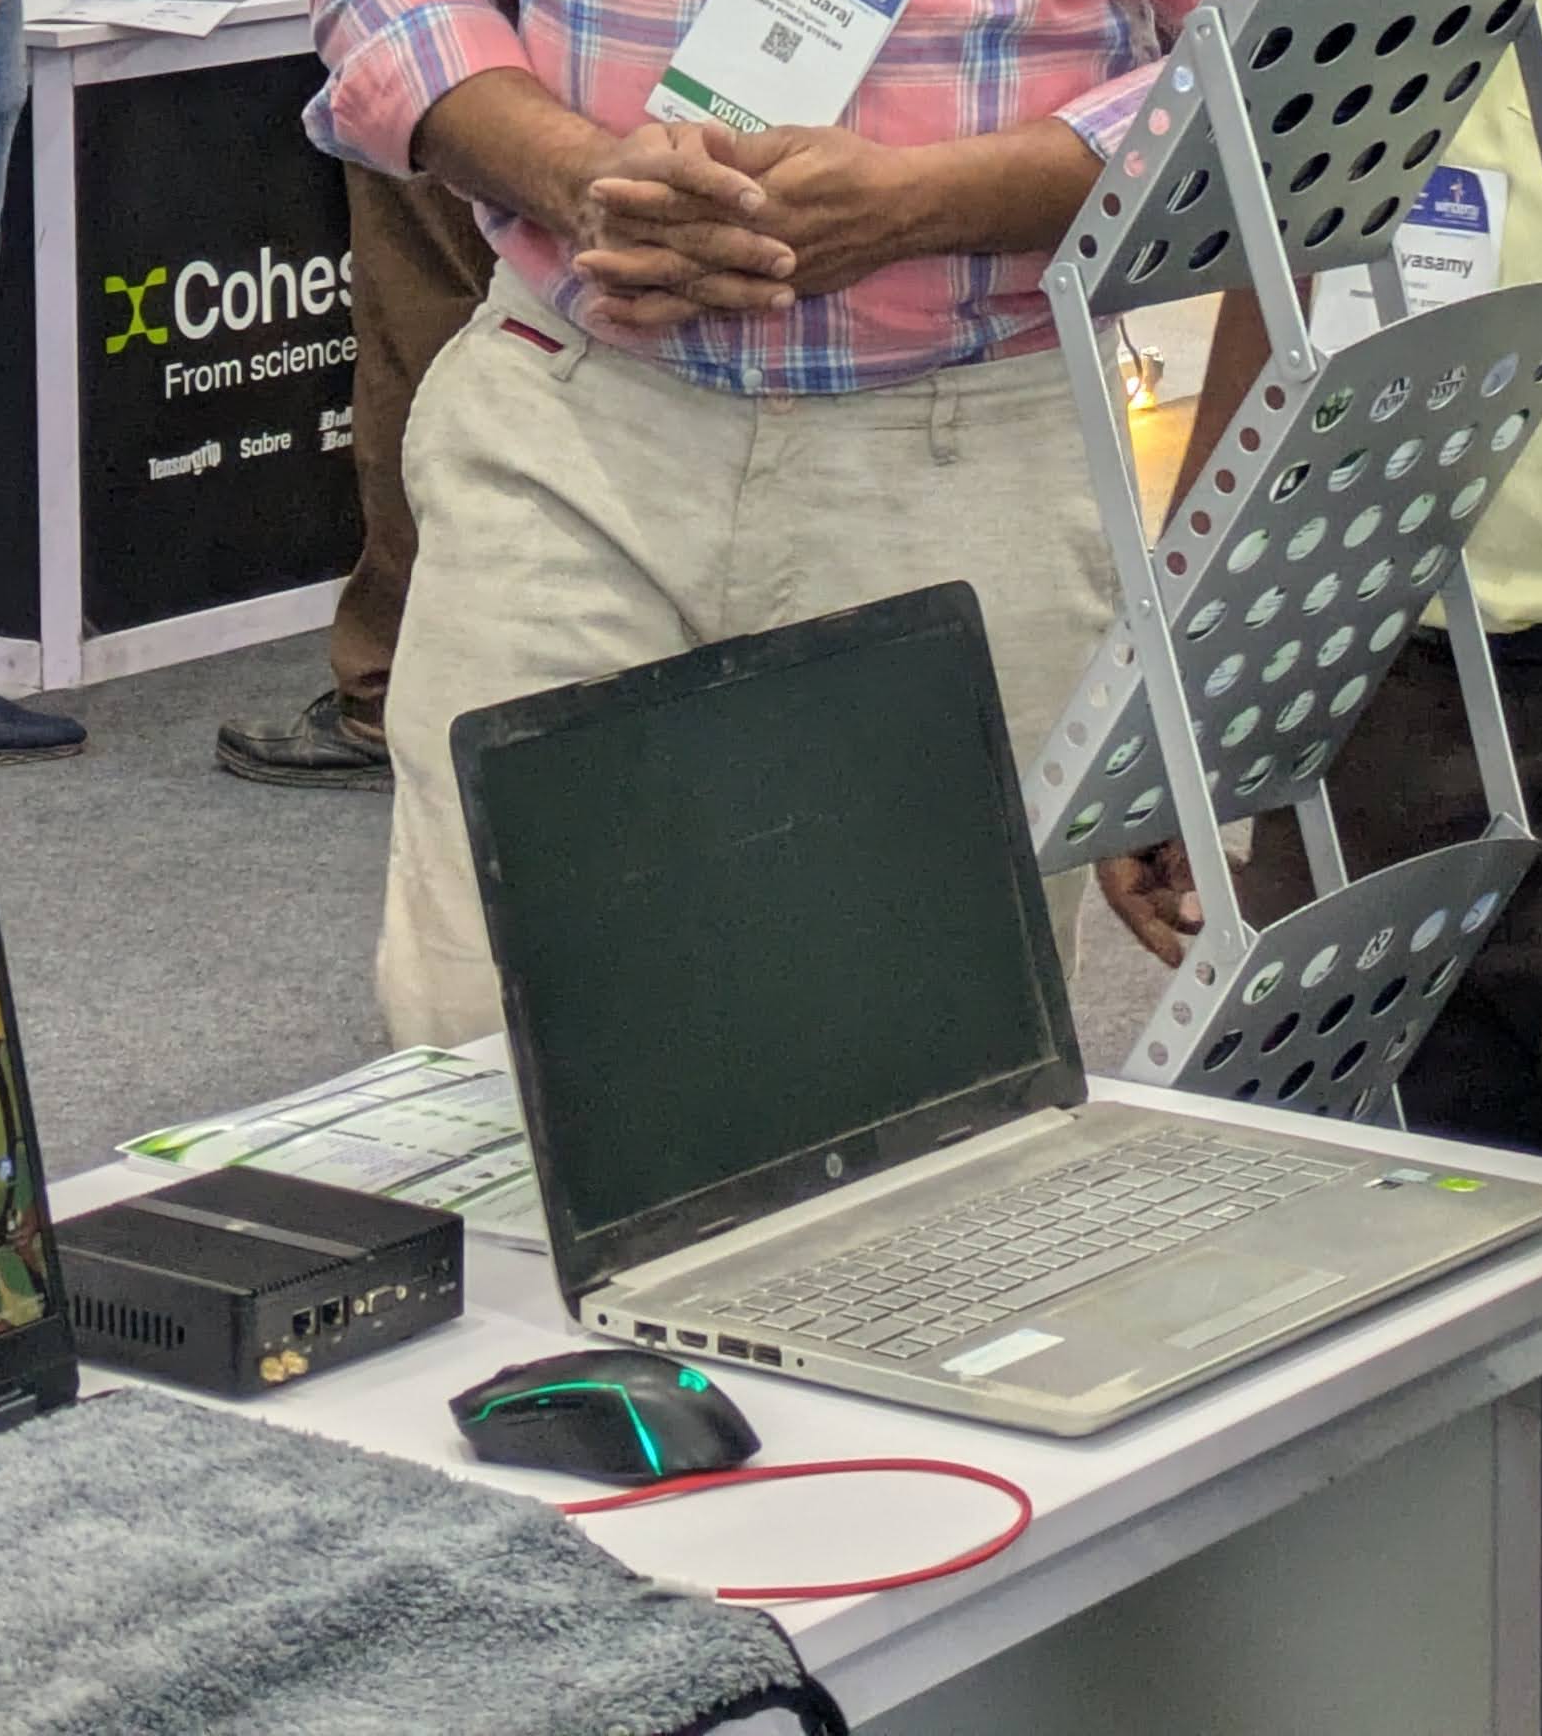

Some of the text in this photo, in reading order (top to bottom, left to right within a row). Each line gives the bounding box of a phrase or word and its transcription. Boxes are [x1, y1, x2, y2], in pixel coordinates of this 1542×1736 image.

[165, 335, 358, 400] From science
[239, 431, 293, 459] Sabre
